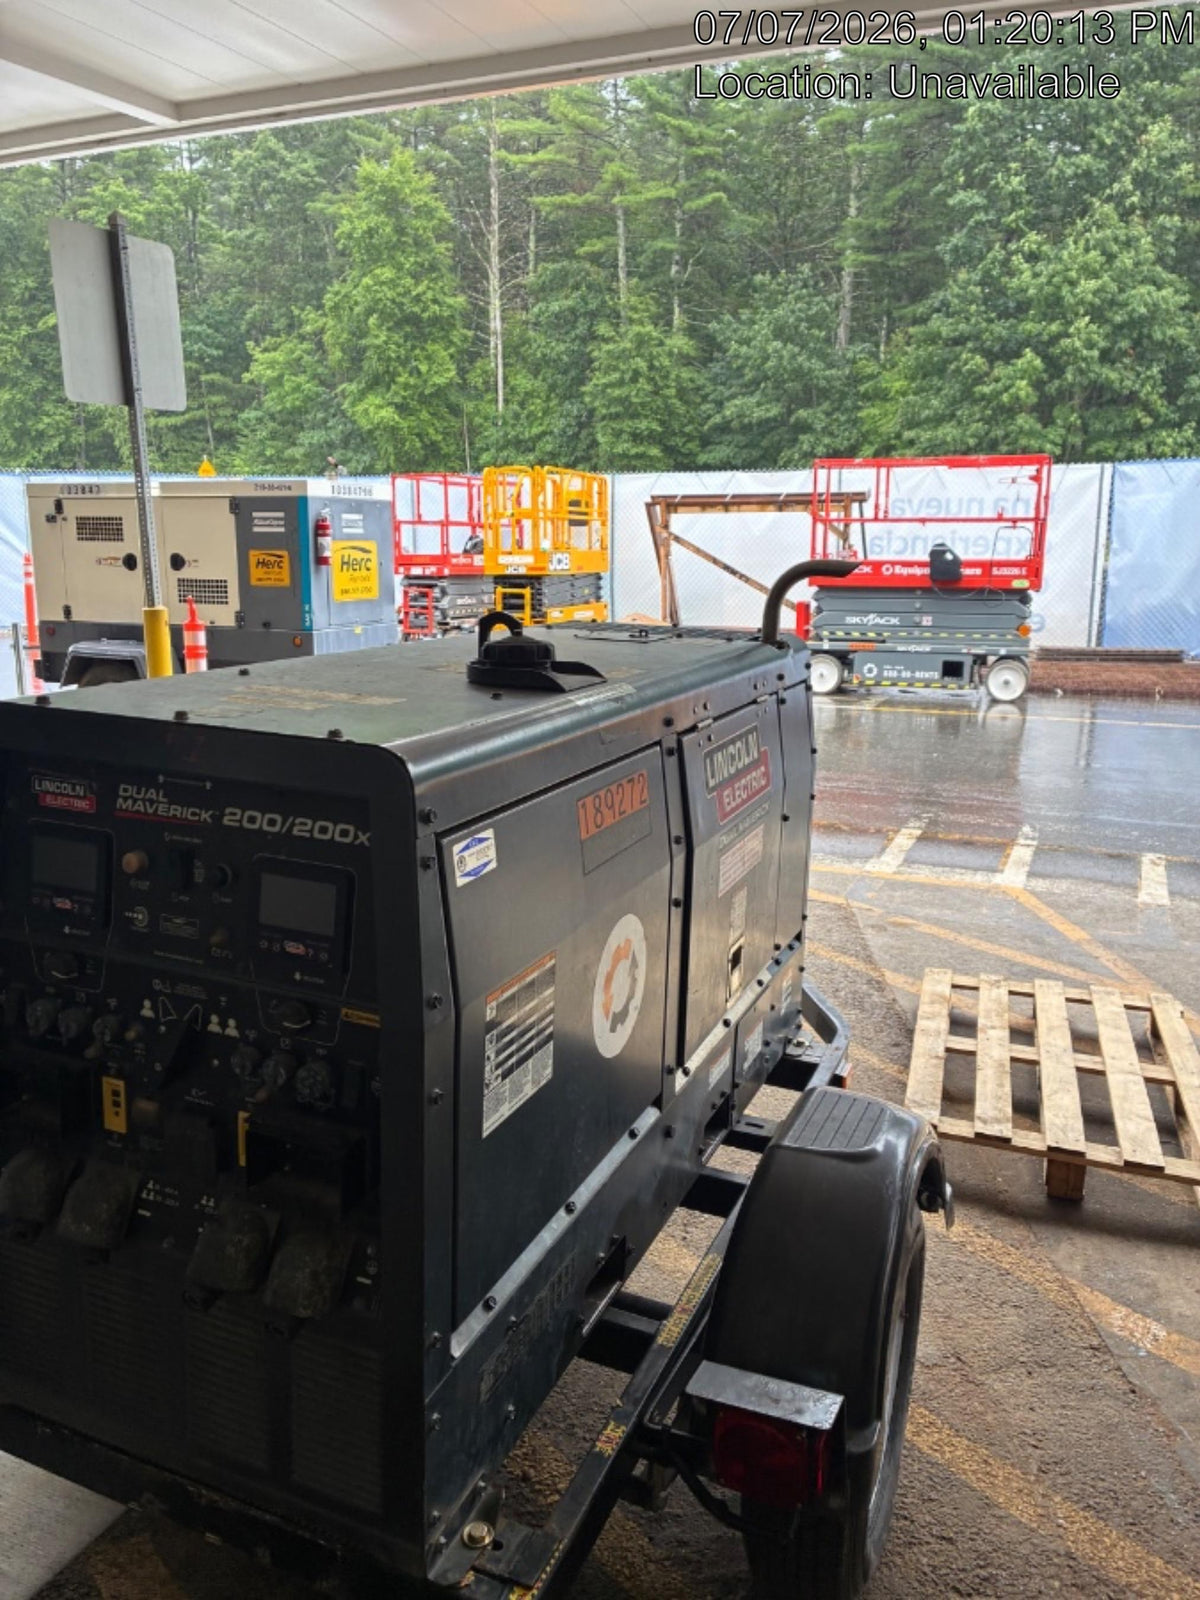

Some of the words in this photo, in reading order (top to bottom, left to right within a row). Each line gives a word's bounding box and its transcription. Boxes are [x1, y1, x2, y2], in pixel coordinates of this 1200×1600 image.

[256, 557, 284, 569] Herc
[340, 555, 372, 573] Herc
[549, 552, 570, 571] JCB
[845, 612, 900, 626] SKYJACK
[705, 731, 759, 789] LINCOLN
[35, 778, 86, 798] LINCOLN
[118, 783, 168, 803] DUAL
[722, 765, 768, 812] ELECTRIC
[116, 797, 215, 823] MAVERICK
[580, 772, 648, 835] 189272
